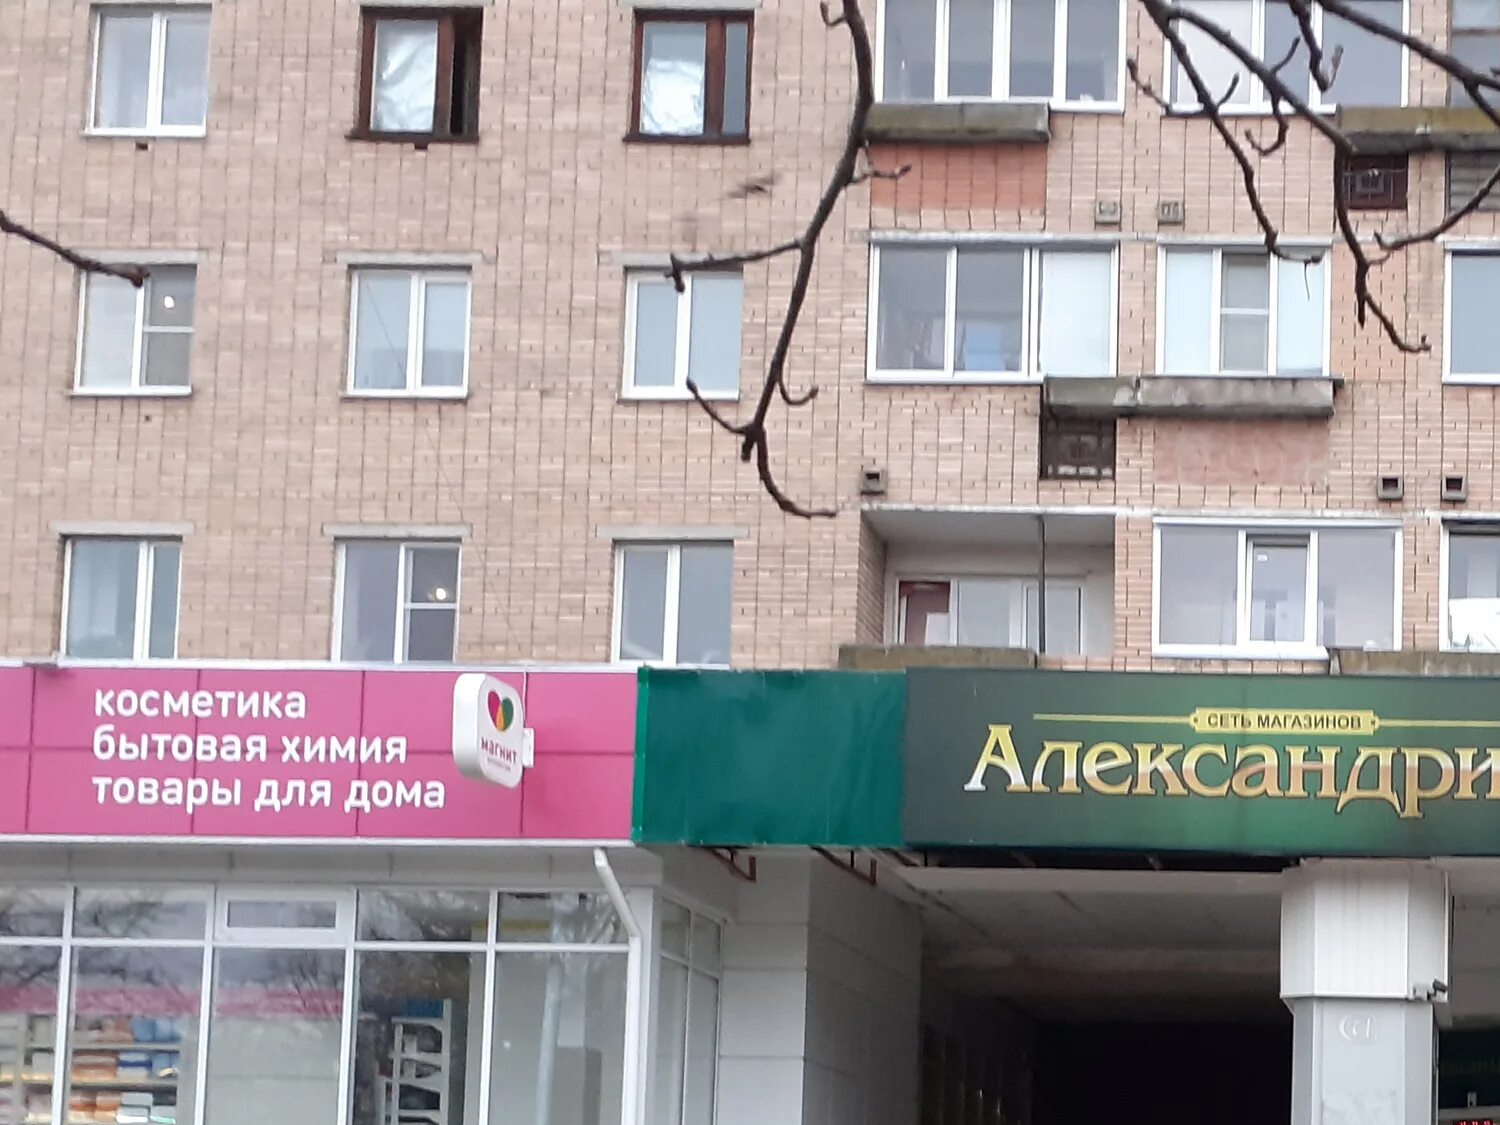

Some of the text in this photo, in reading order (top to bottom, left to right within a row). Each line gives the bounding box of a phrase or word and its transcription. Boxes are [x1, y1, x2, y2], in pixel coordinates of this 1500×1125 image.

[94, 689, 307, 718] косметика
[1207, 713, 1361, 729] СЕТЬ МАГАЗИНОВ
[92, 724, 407, 763] бытовая химия
[481, 736, 517, 765] магнит
[91, 777, 445, 814] товары для дома
